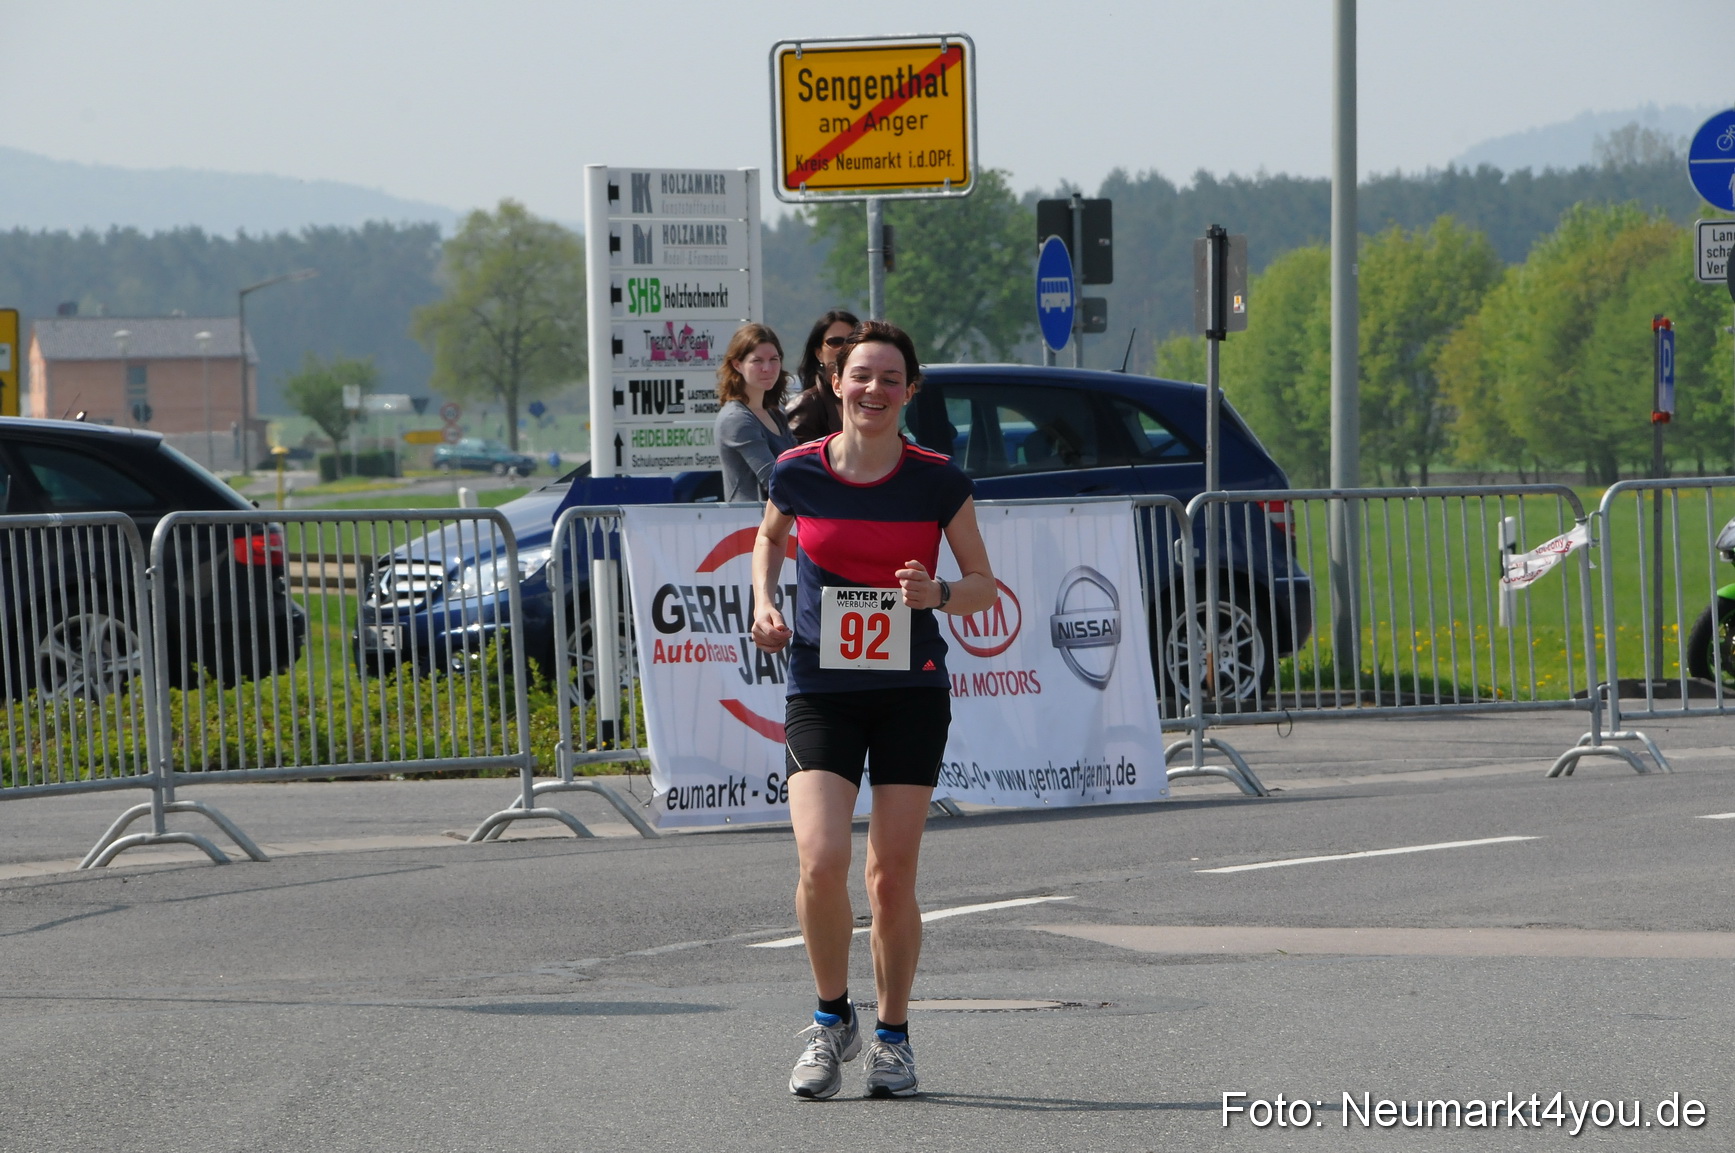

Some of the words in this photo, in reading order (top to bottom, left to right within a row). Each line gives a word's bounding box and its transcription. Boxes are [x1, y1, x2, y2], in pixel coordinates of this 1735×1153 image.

[798, 63, 949, 110] Sengenthal
[819, 116, 851, 133] am
[863, 111, 929, 136] Anger
[795, 154, 830, 172] Kreis
[836, 152, 902, 170] Neumarkt
[909, 149, 955, 168] i.d.OPf.
[661, 173, 726, 195] HOLZAMMER
[662, 224, 728, 246] HOLZAMMER
[1712, 228, 1735, 242] Lan
[1706, 261, 1729, 275] Ver
[628, 277, 662, 317] SHB
[664, 282, 729, 309] Holzfachmarkt
[643, 329, 673, 350] Trend
[679, 329, 715, 350] Creativ
[629, 379, 685, 415] THULE
[836, 600, 878, 608] WERBUNG
[837, 590, 878, 601] MEYER
[840, 611, 891, 660] 92
[653, 638, 738, 664] Autohaus
[949, 673, 970, 697] IA
[973, 670, 1041, 697] MOTORS
[667, 775, 747, 810] eumarkt
[765, 772, 788, 805] Se
[991, 755, 1137, 798] www.gerhart-jaenig.de
